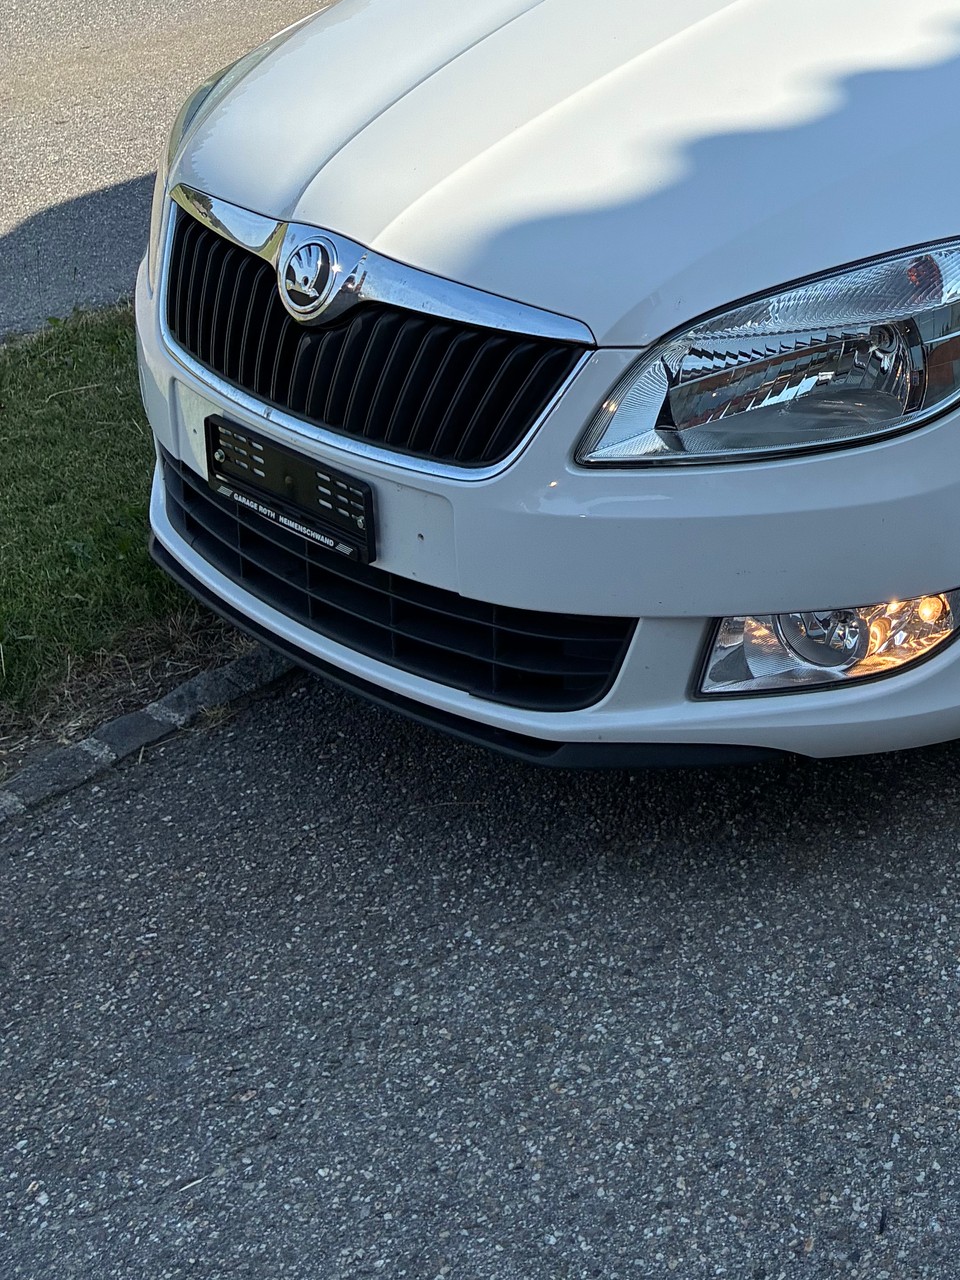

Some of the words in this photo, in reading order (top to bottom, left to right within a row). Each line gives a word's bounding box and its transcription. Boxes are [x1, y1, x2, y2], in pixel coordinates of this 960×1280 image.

[233, 493, 258, 510] GARAGE
[258, 505, 276, 519] ROTH
[278, 515, 334, 547] HEIMENSCHWAND
